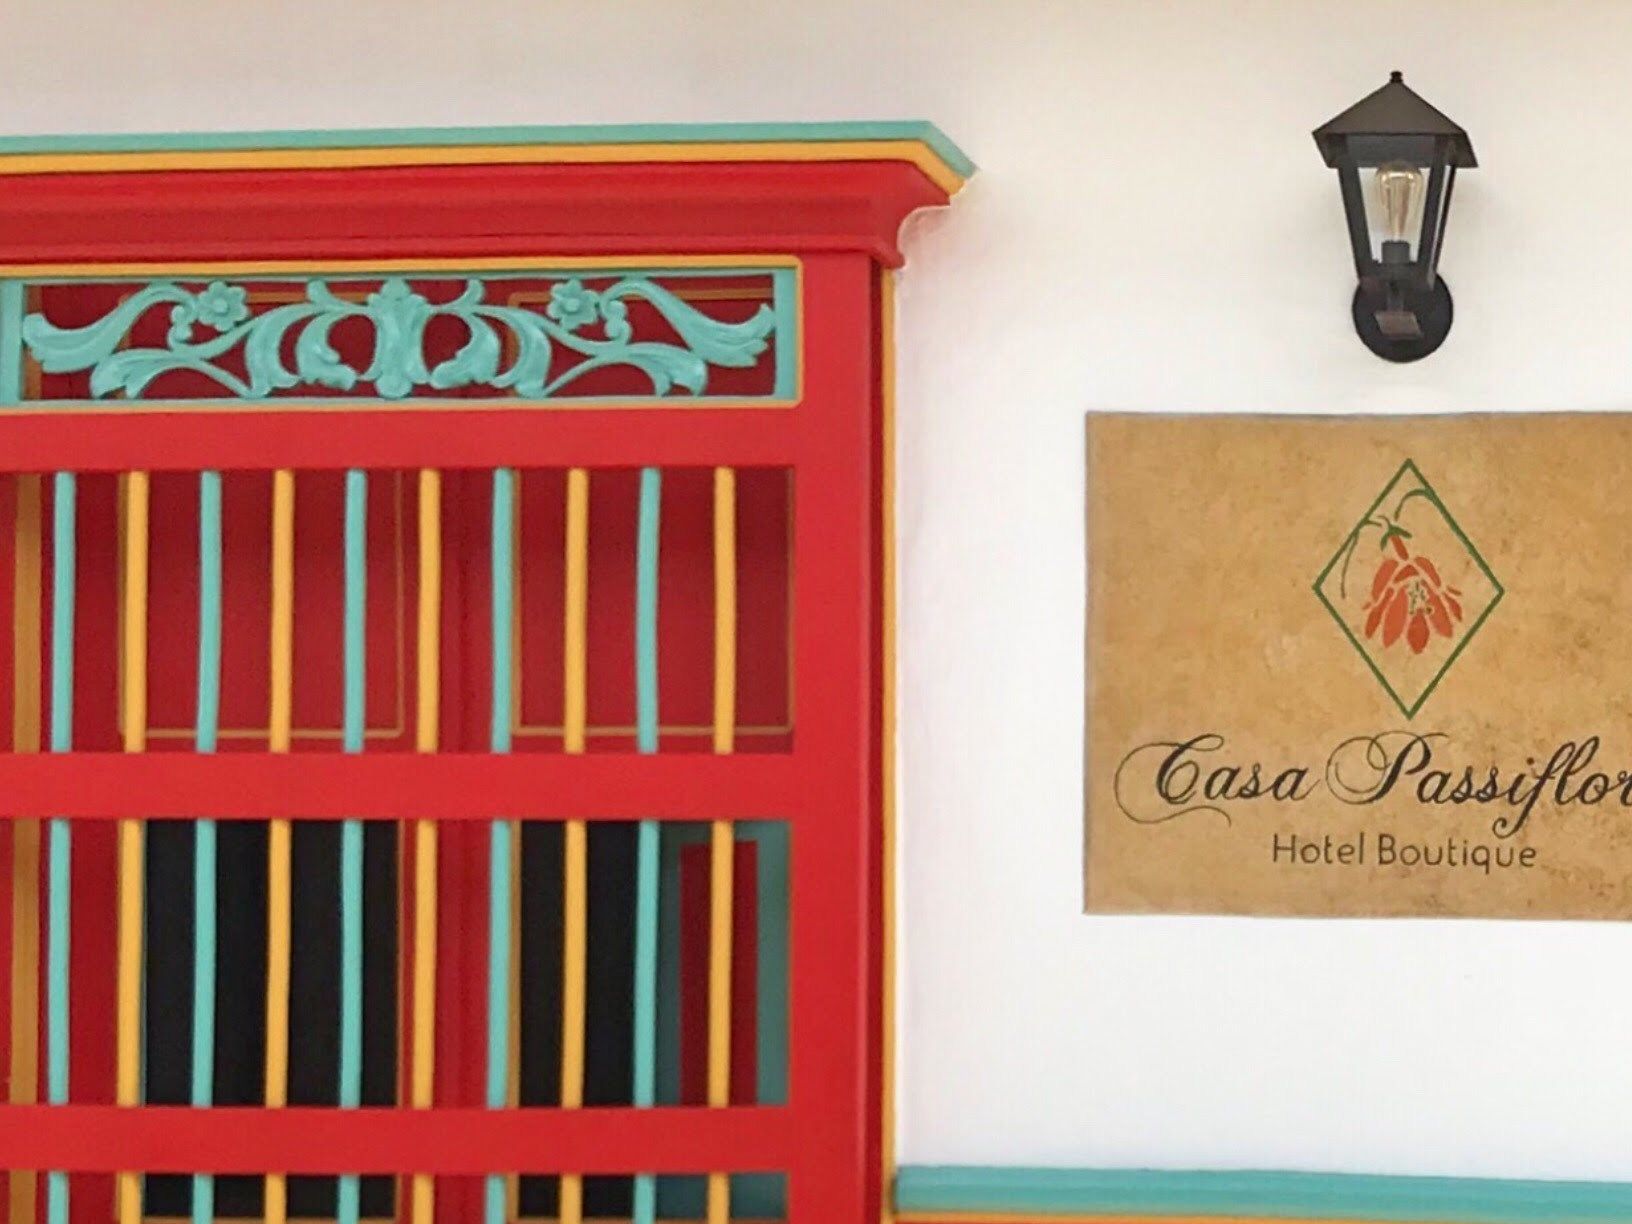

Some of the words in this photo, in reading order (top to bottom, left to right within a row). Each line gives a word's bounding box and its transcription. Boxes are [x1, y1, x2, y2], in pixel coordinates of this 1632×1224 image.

[1114, 733, 1320, 825] Casa
[1272, 833, 1365, 866] Hotel
[1378, 834, 1537, 873] Boutique
